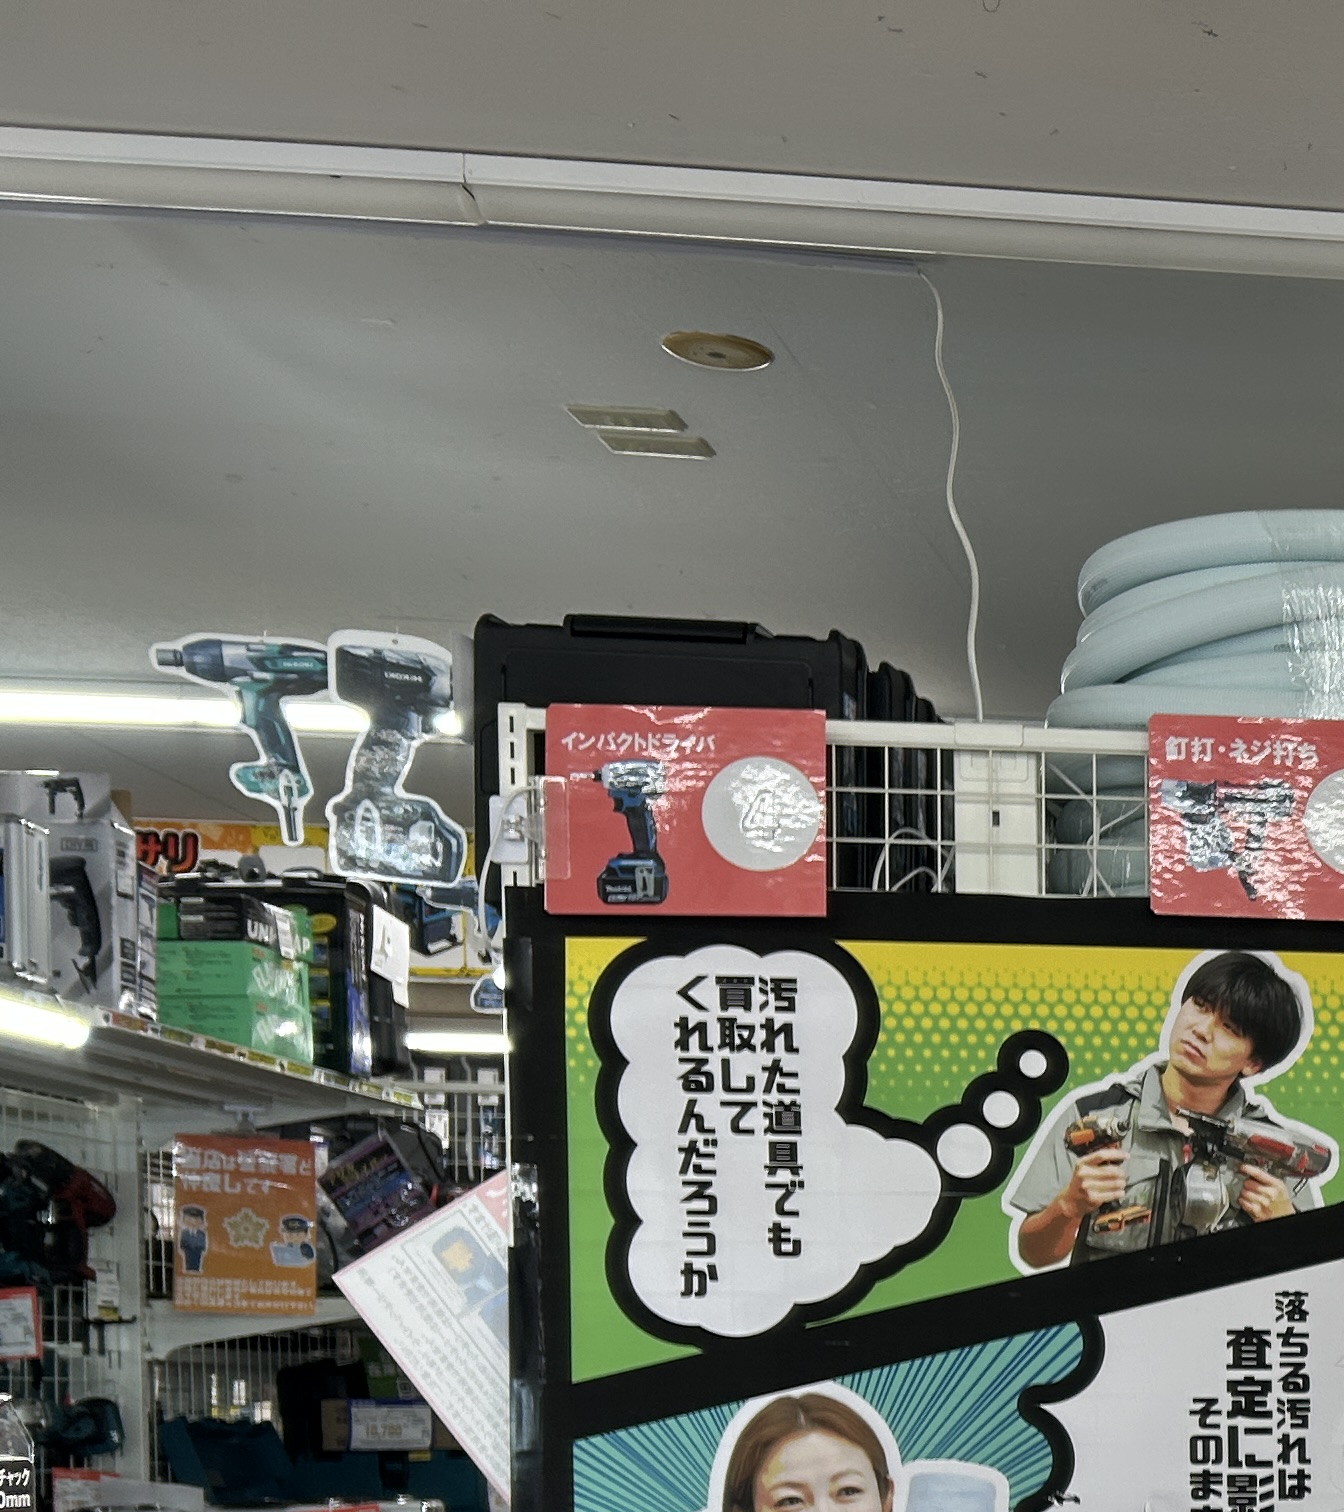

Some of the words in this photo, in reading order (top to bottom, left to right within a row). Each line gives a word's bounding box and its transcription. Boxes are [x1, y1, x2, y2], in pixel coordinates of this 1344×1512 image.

[561, 731, 717, 753] インパクトドライバ
[1165, 735, 1319, 767] 釘打・ネジ打ち
[673, 976, 718, 1300] くれるんだろうか
[713, 976, 757, 1137] 買取して
[758, 975, 803, 1258] 汚れた道具でも
[1274, 1290, 1312, 1503] 落ちる汚れは
